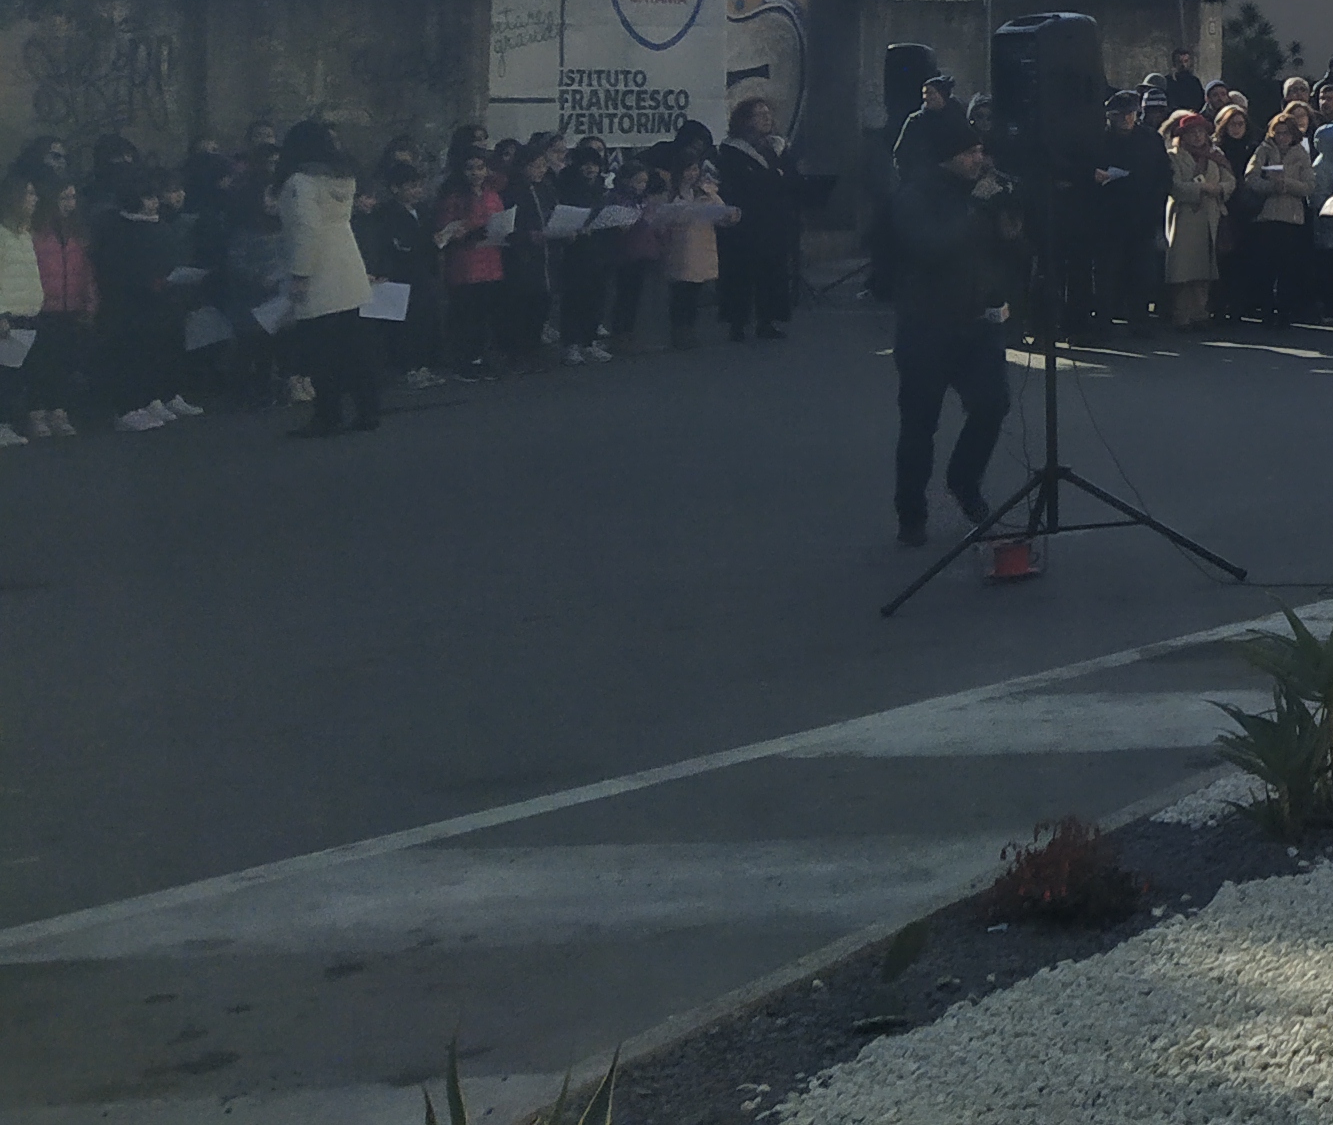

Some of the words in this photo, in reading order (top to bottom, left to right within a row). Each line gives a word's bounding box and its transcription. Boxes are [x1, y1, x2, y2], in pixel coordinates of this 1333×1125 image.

[558, 68, 647, 88] ISTITUTO
[558, 88, 690, 112] FRANCESCO
[557, 112, 688, 136] VENTORINO
